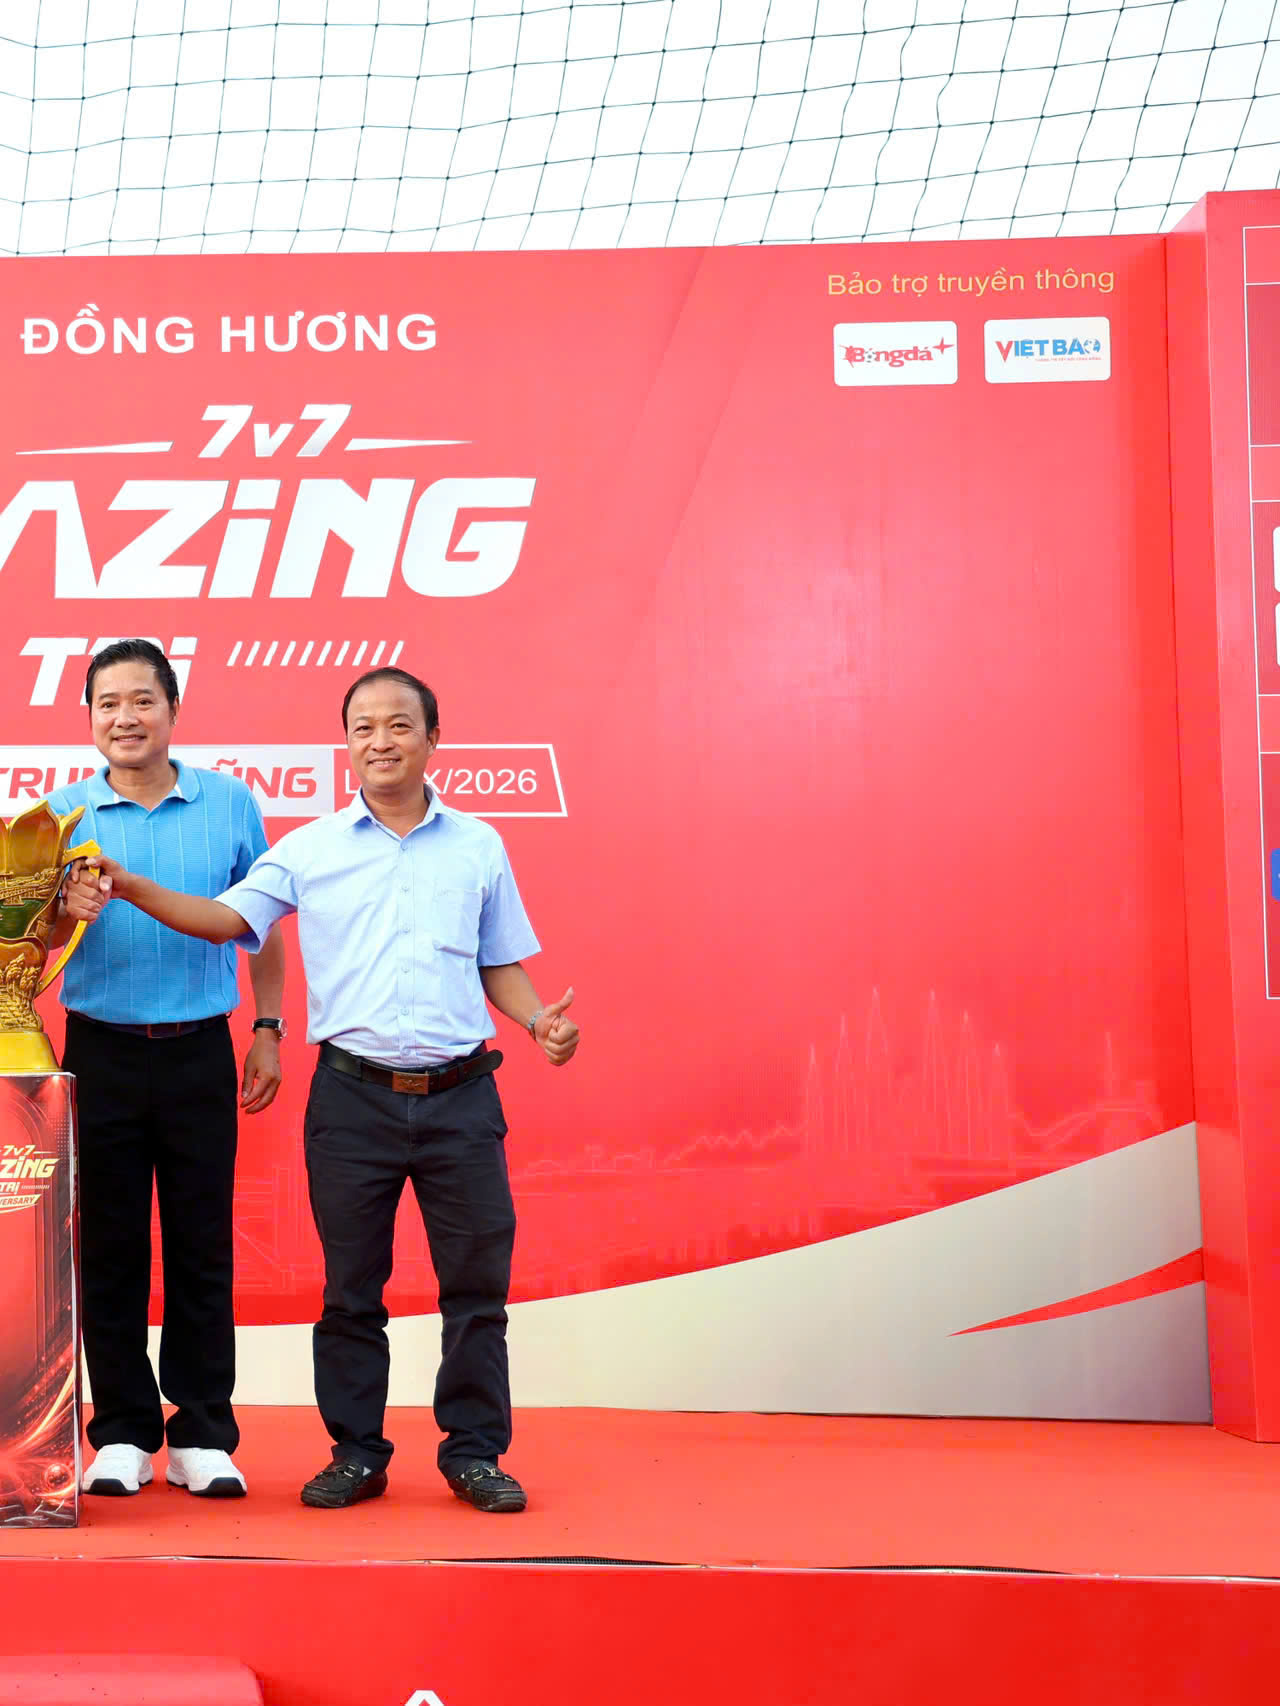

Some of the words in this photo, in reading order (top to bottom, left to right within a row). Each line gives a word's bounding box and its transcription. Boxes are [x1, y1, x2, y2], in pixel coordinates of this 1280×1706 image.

[828, 271, 882, 296] Bảo
[891, 274, 929, 297] trợ
[937, 266, 1025, 297] truyền
[1034, 267, 1115, 293] thông
[20, 303, 195, 354] ĐỒNG
[220, 310, 437, 352] HƯƠNG
[198, 403, 352, 458] 7v7
[3, 1145, 36, 1156] 7v7
